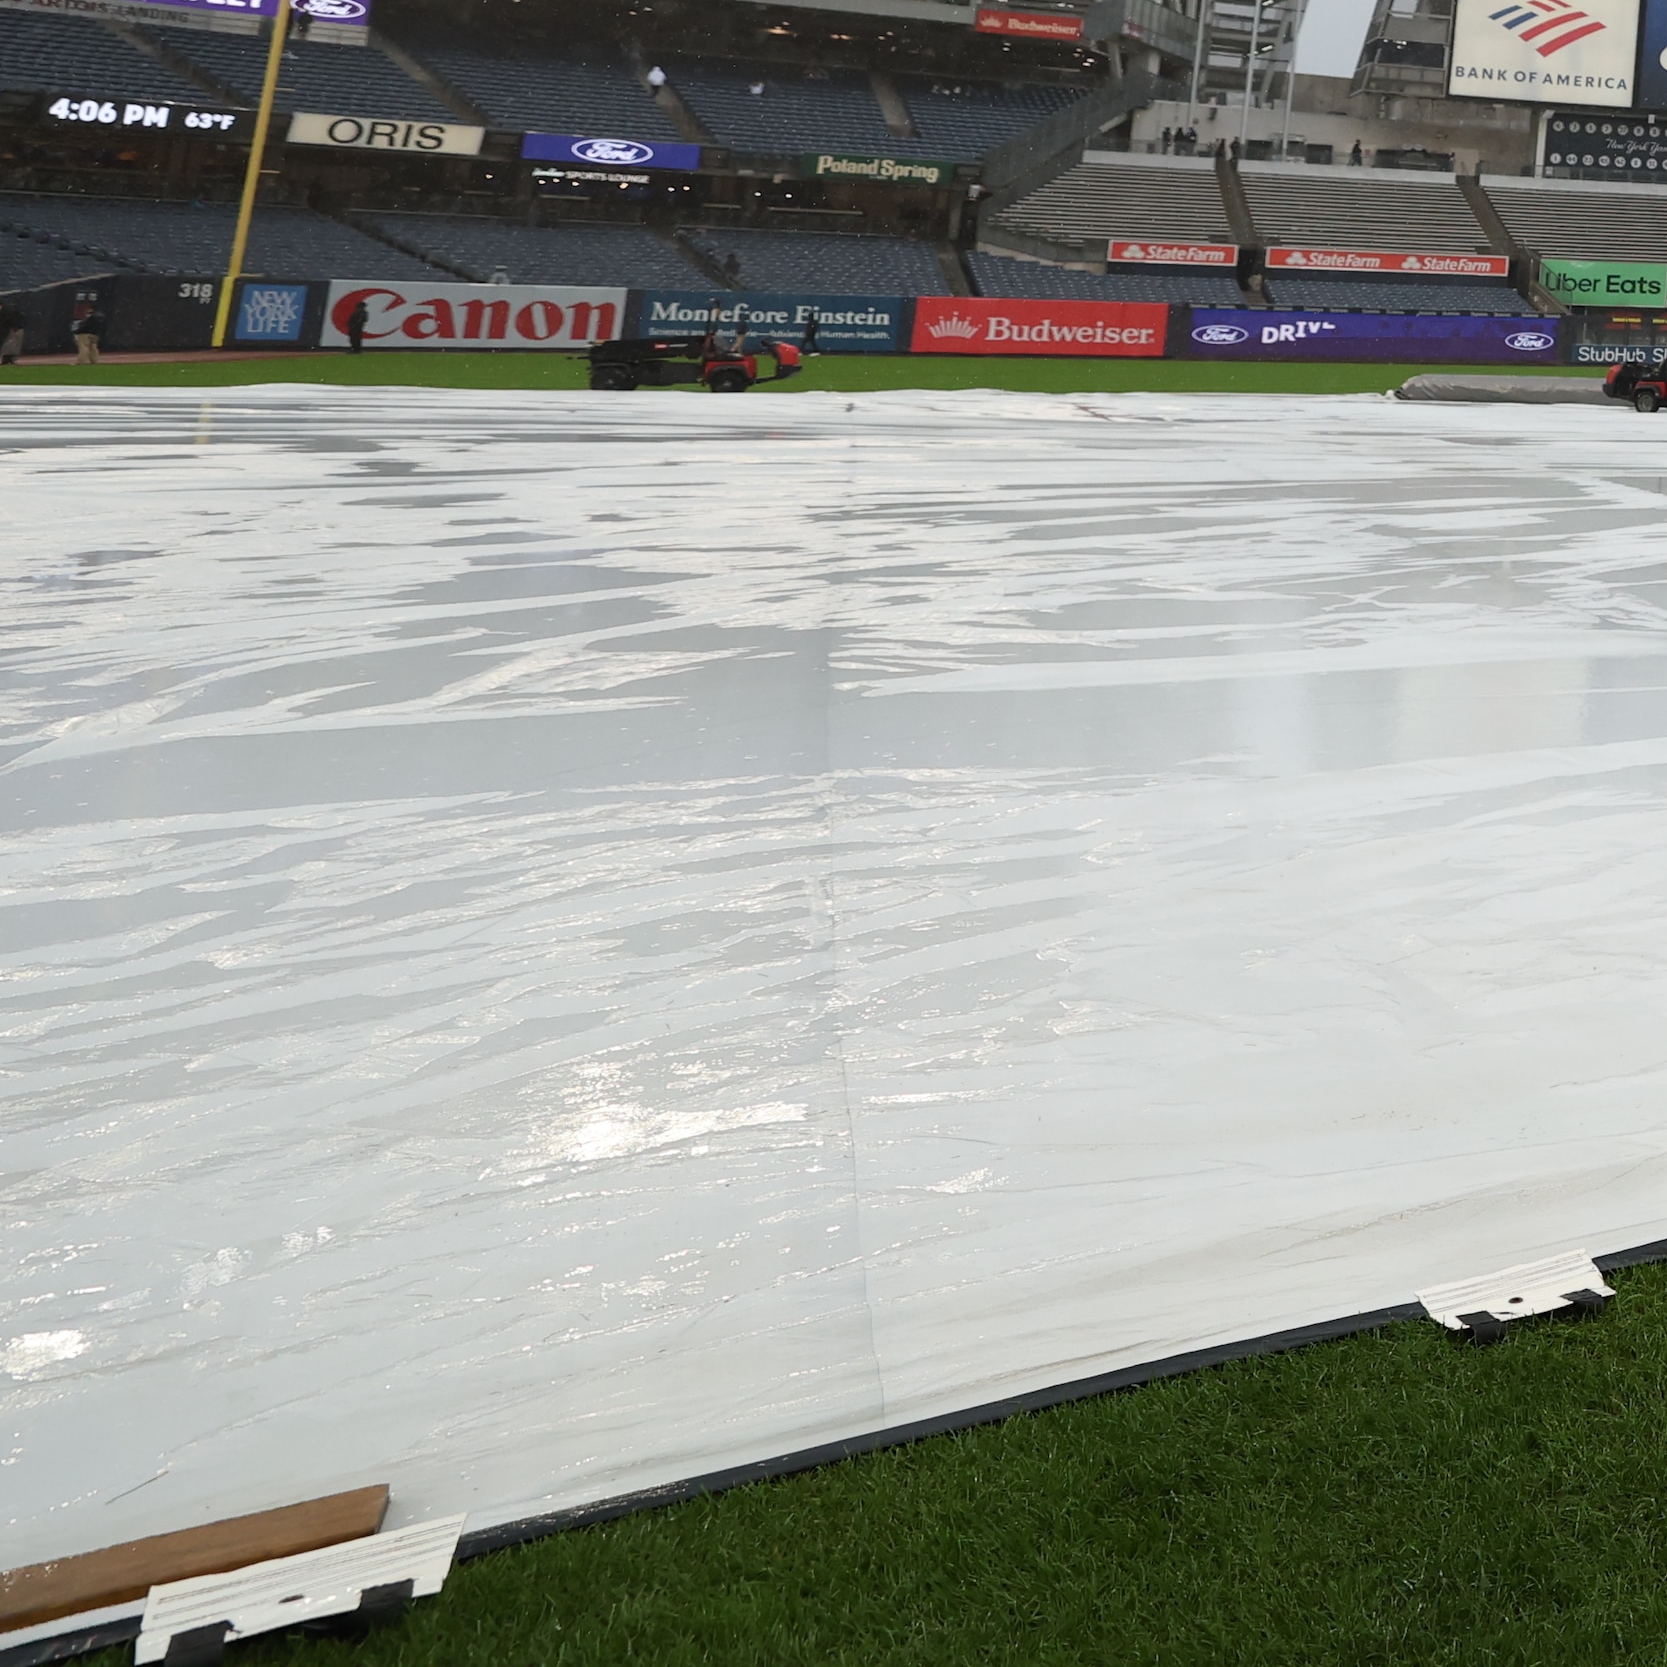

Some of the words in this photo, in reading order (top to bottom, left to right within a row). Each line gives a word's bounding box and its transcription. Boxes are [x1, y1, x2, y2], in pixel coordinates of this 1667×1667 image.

[1455, 65, 1508, 82] BANK
[1513, 70, 1538, 83] OF
[1543, 72, 1627, 91] AMERICA
[50, 98, 117, 124] 4:06
[123, 104, 170, 128] PM
[327, 118, 446, 150] ORIS
[817, 155, 878, 176] Poland
[880, 159, 939, 183] Spring
[1545, 273, 1600, 293] Uber
[1607, 275, 1661, 295] Eats
[331, 288, 617, 340] Canon
[985, 317, 1153, 344] Budweiser
[1578, 347, 1646, 363] StubHub
